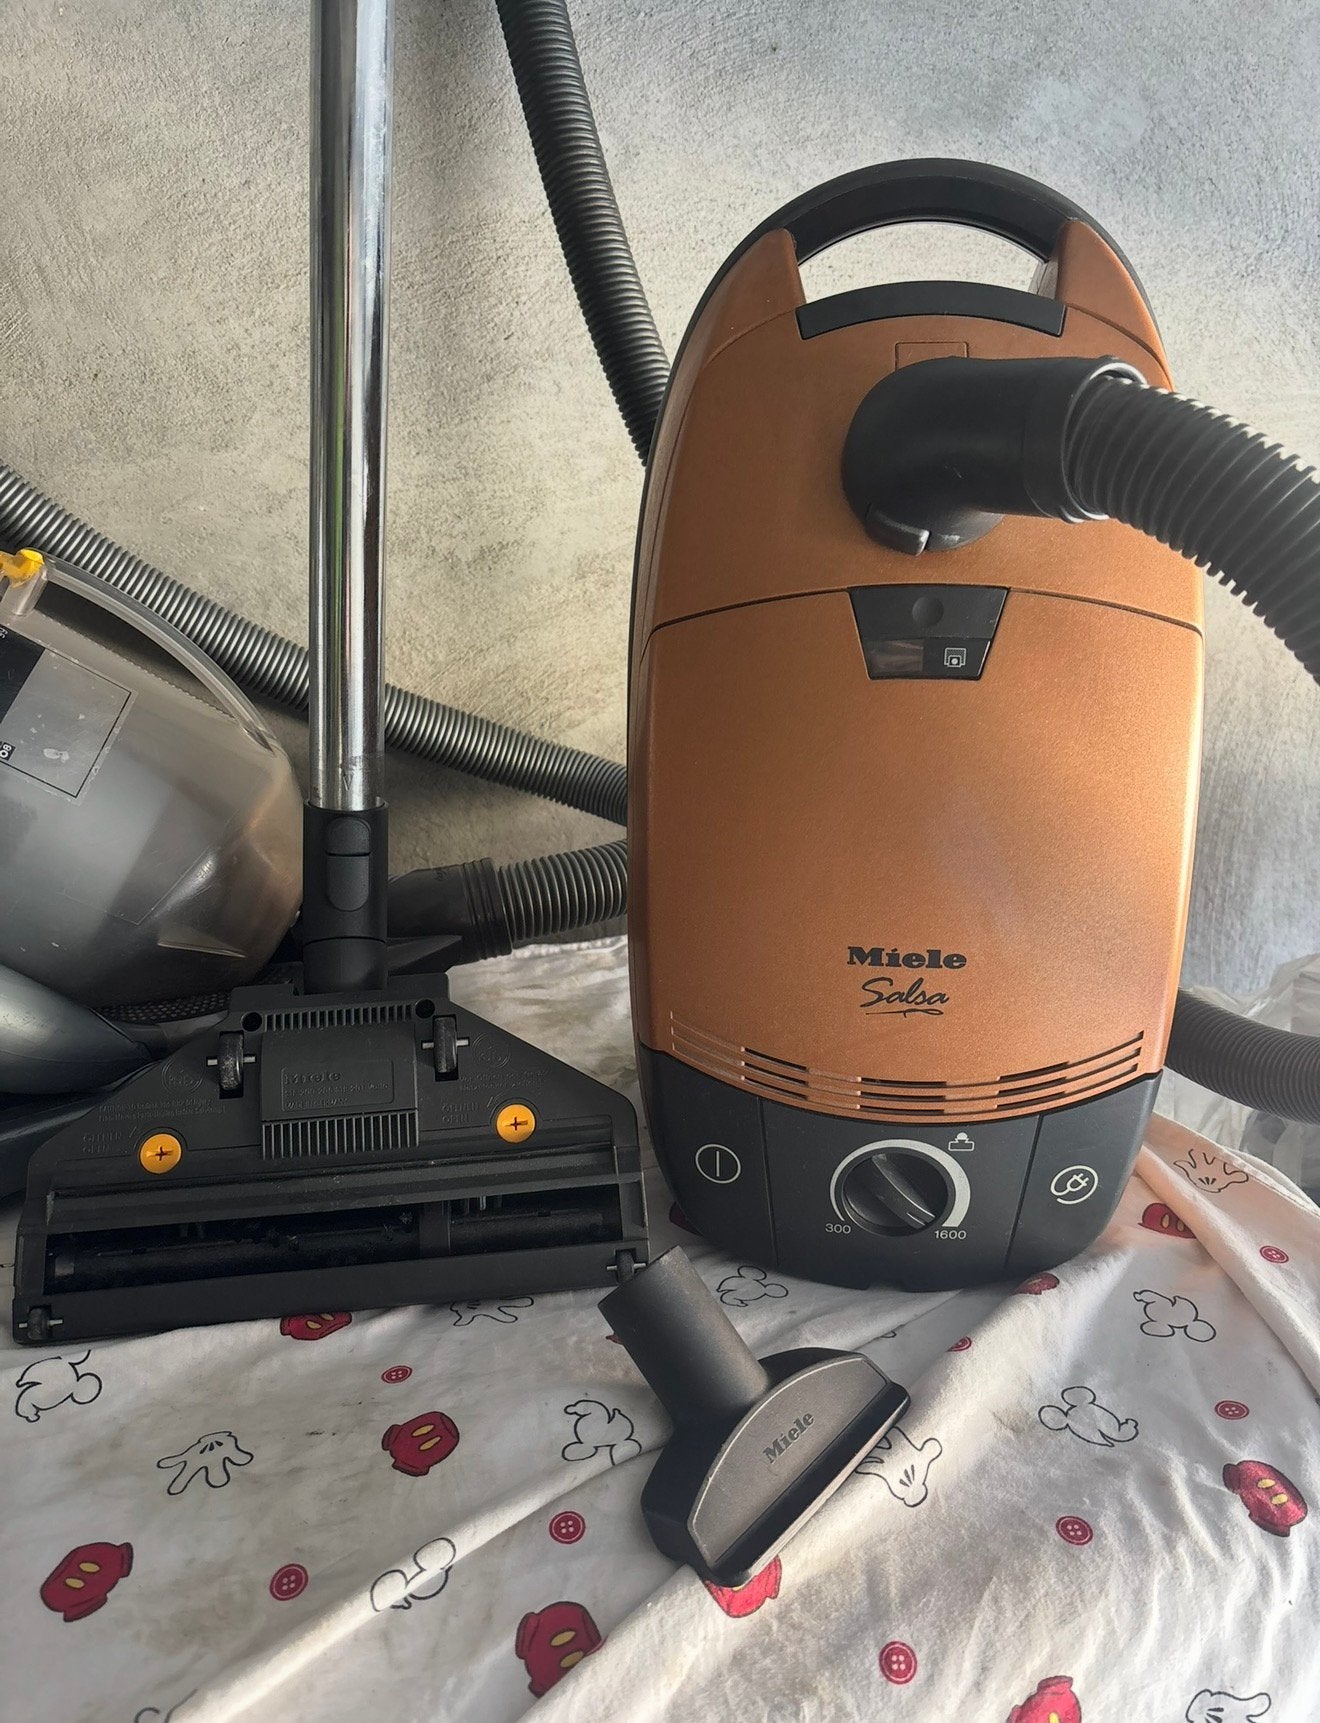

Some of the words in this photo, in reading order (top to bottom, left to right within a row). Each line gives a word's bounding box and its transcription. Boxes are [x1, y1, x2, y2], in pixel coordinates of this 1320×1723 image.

[847, 946, 967, 969] Miele
[859, 976, 950, 1009] Salsa
[825, 1223, 851, 1235] 300
[934, 1229, 967, 1241] 1600
[762, 1412, 815, 1464] Miele
